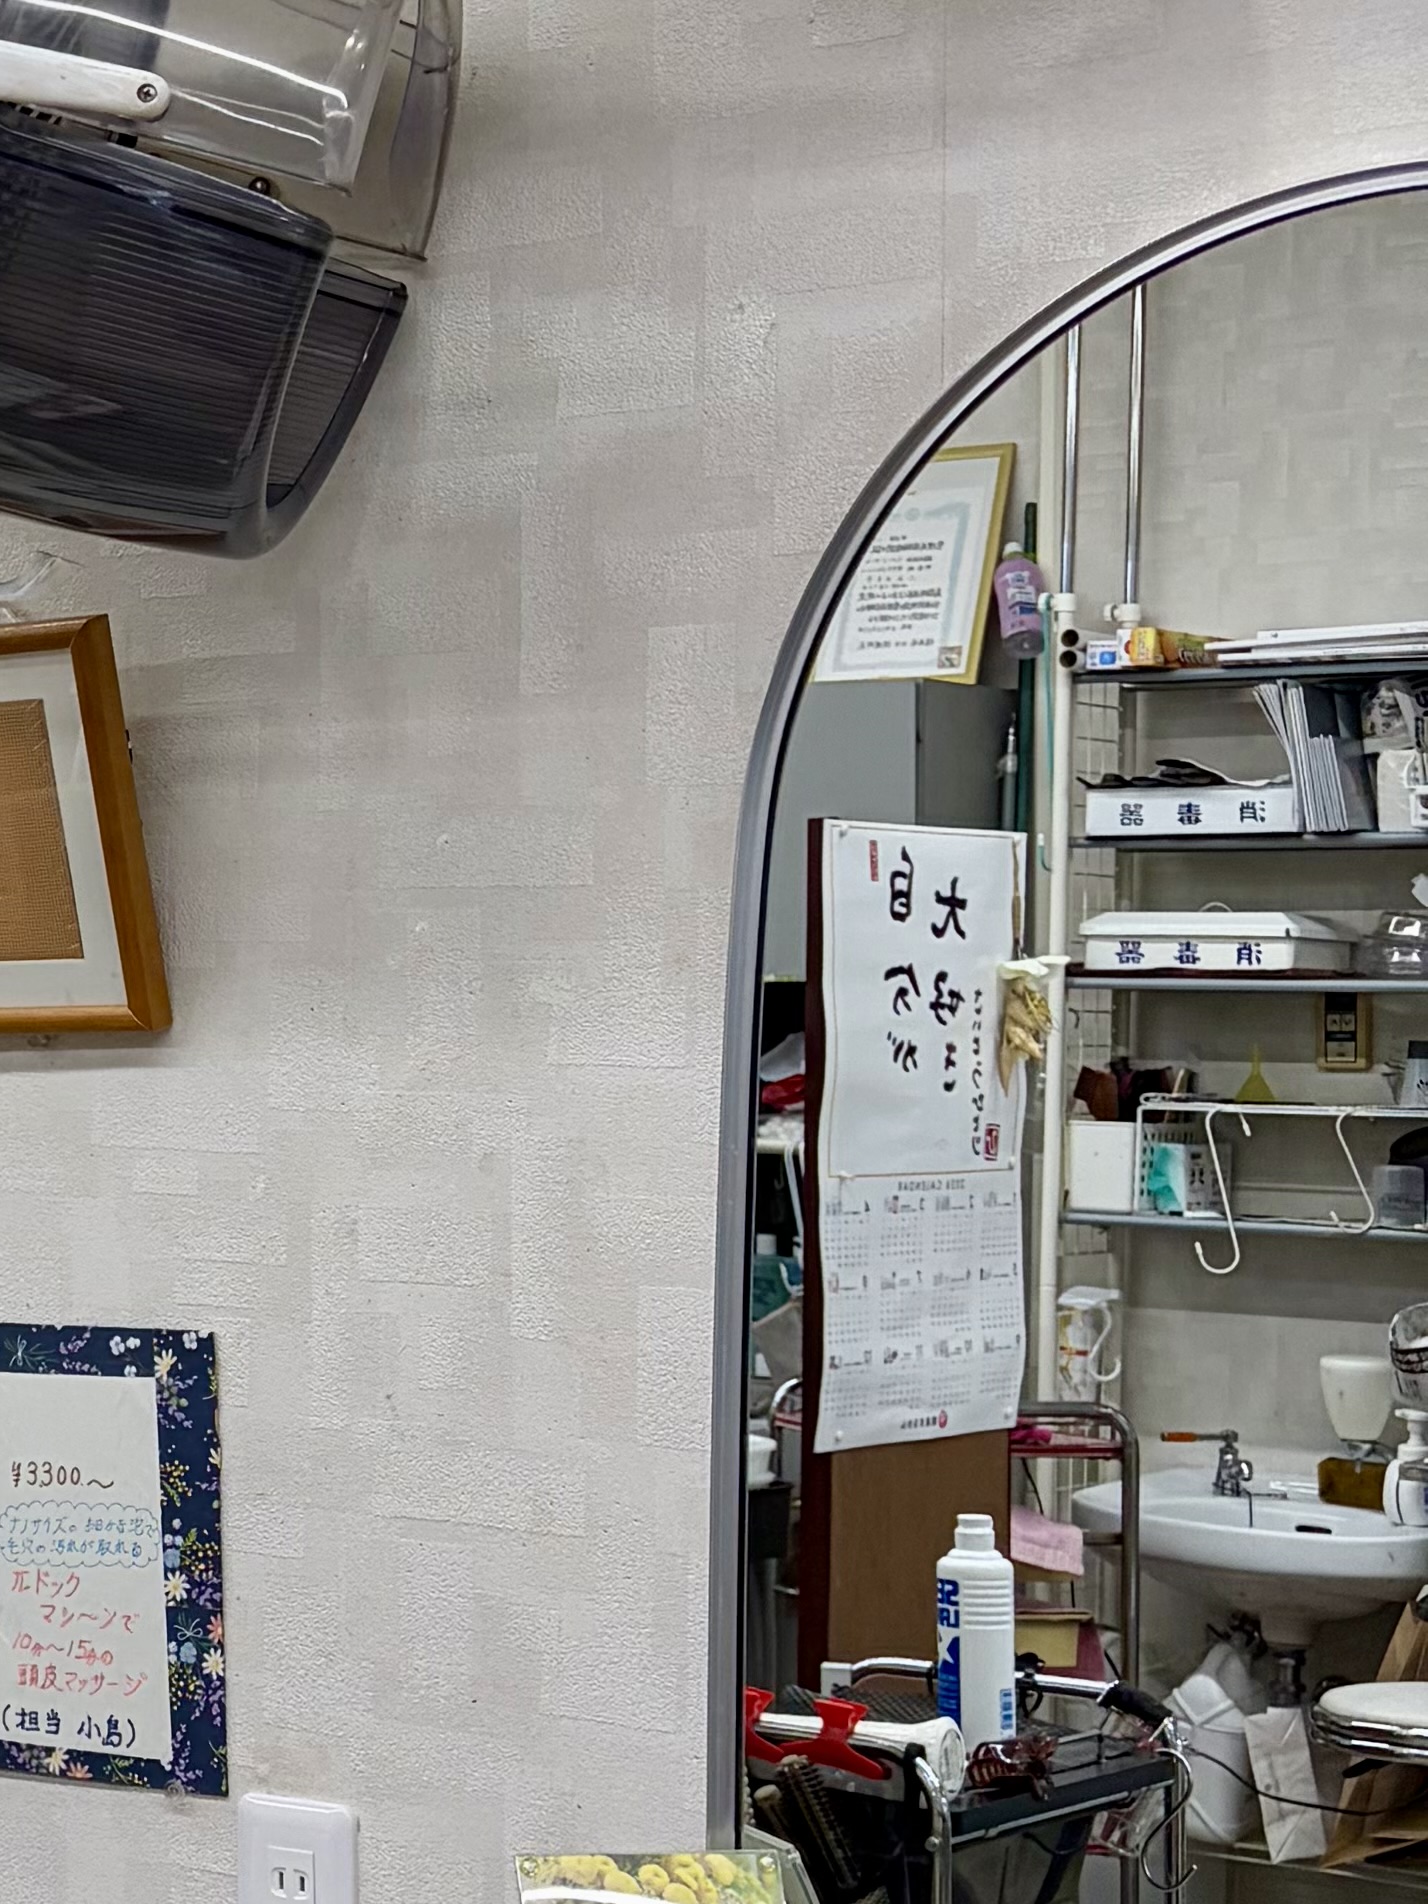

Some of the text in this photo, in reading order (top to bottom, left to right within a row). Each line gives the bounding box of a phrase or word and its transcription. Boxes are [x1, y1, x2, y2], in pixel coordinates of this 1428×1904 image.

[17, 1662, 148, 1697] 頭皮マッサージ
